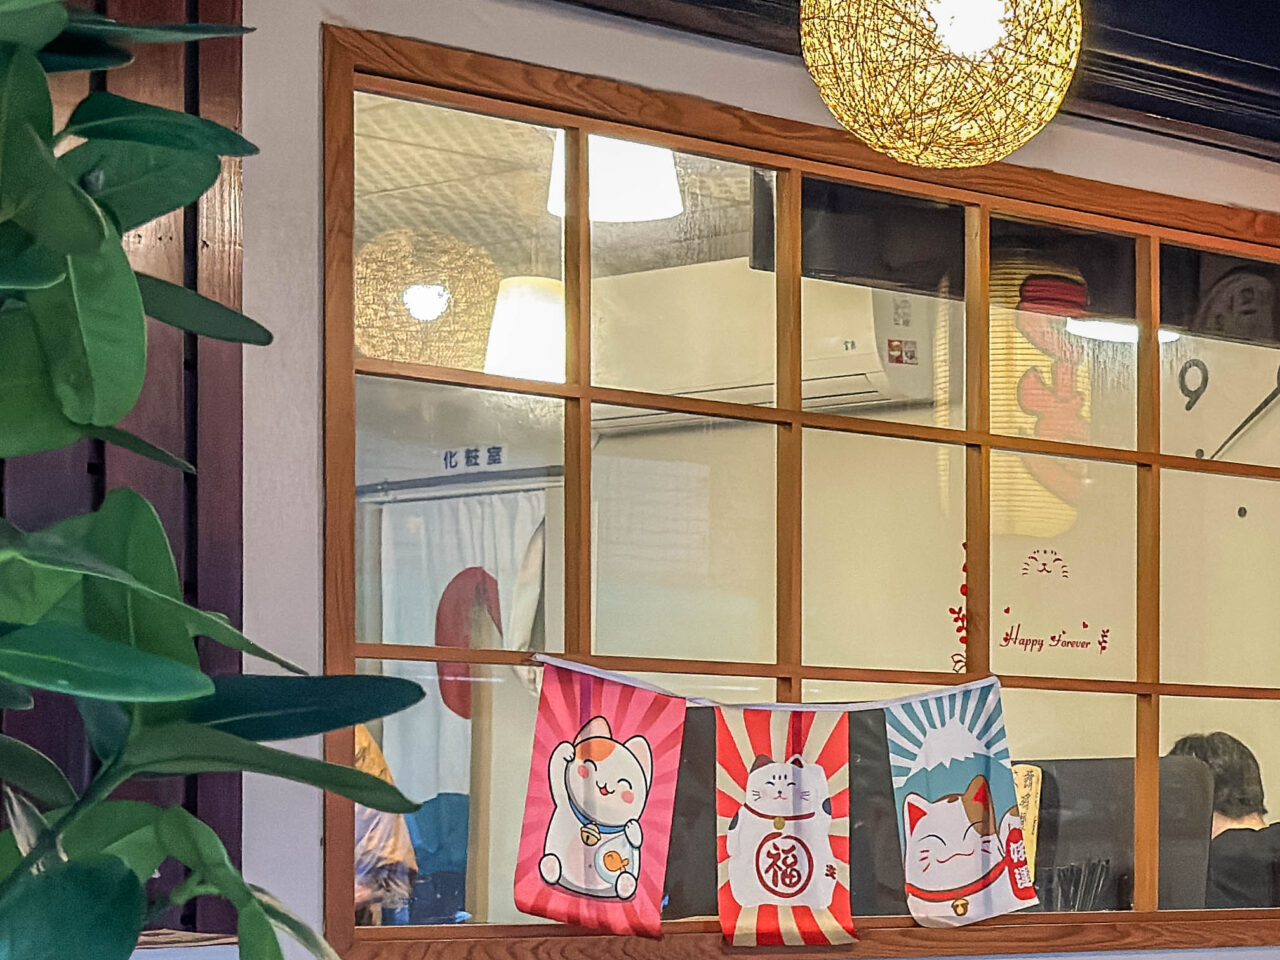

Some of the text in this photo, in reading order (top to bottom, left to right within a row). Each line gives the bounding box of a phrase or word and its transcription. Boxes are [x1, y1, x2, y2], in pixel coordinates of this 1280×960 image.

[1179, 359, 1208, 411] 9
[443, 446, 502, 470] 化粧室
[999, 624, 1091, 652] Happy Forever
[764, 842, 801, 888] 福
